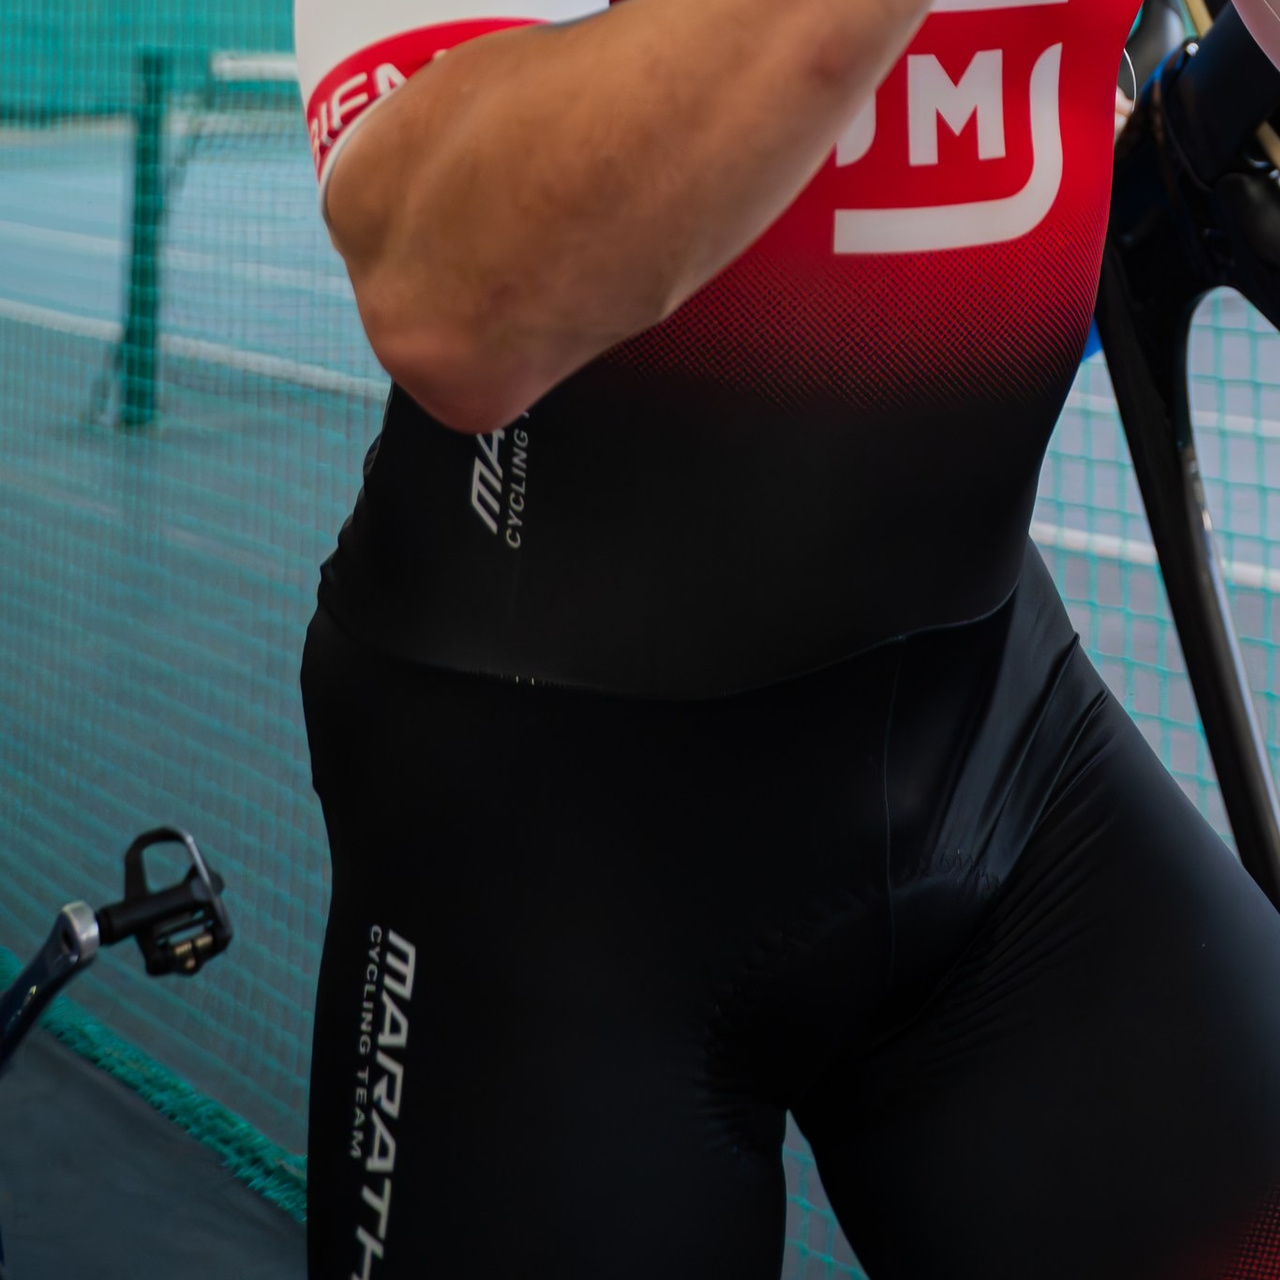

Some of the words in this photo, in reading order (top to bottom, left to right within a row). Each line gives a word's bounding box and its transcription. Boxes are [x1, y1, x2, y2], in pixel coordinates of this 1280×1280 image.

[506, 428, 530, 550] CYCLING
[358, 925, 383, 1056] CYCLING
[349, 1062, 370, 1159] TEAM
